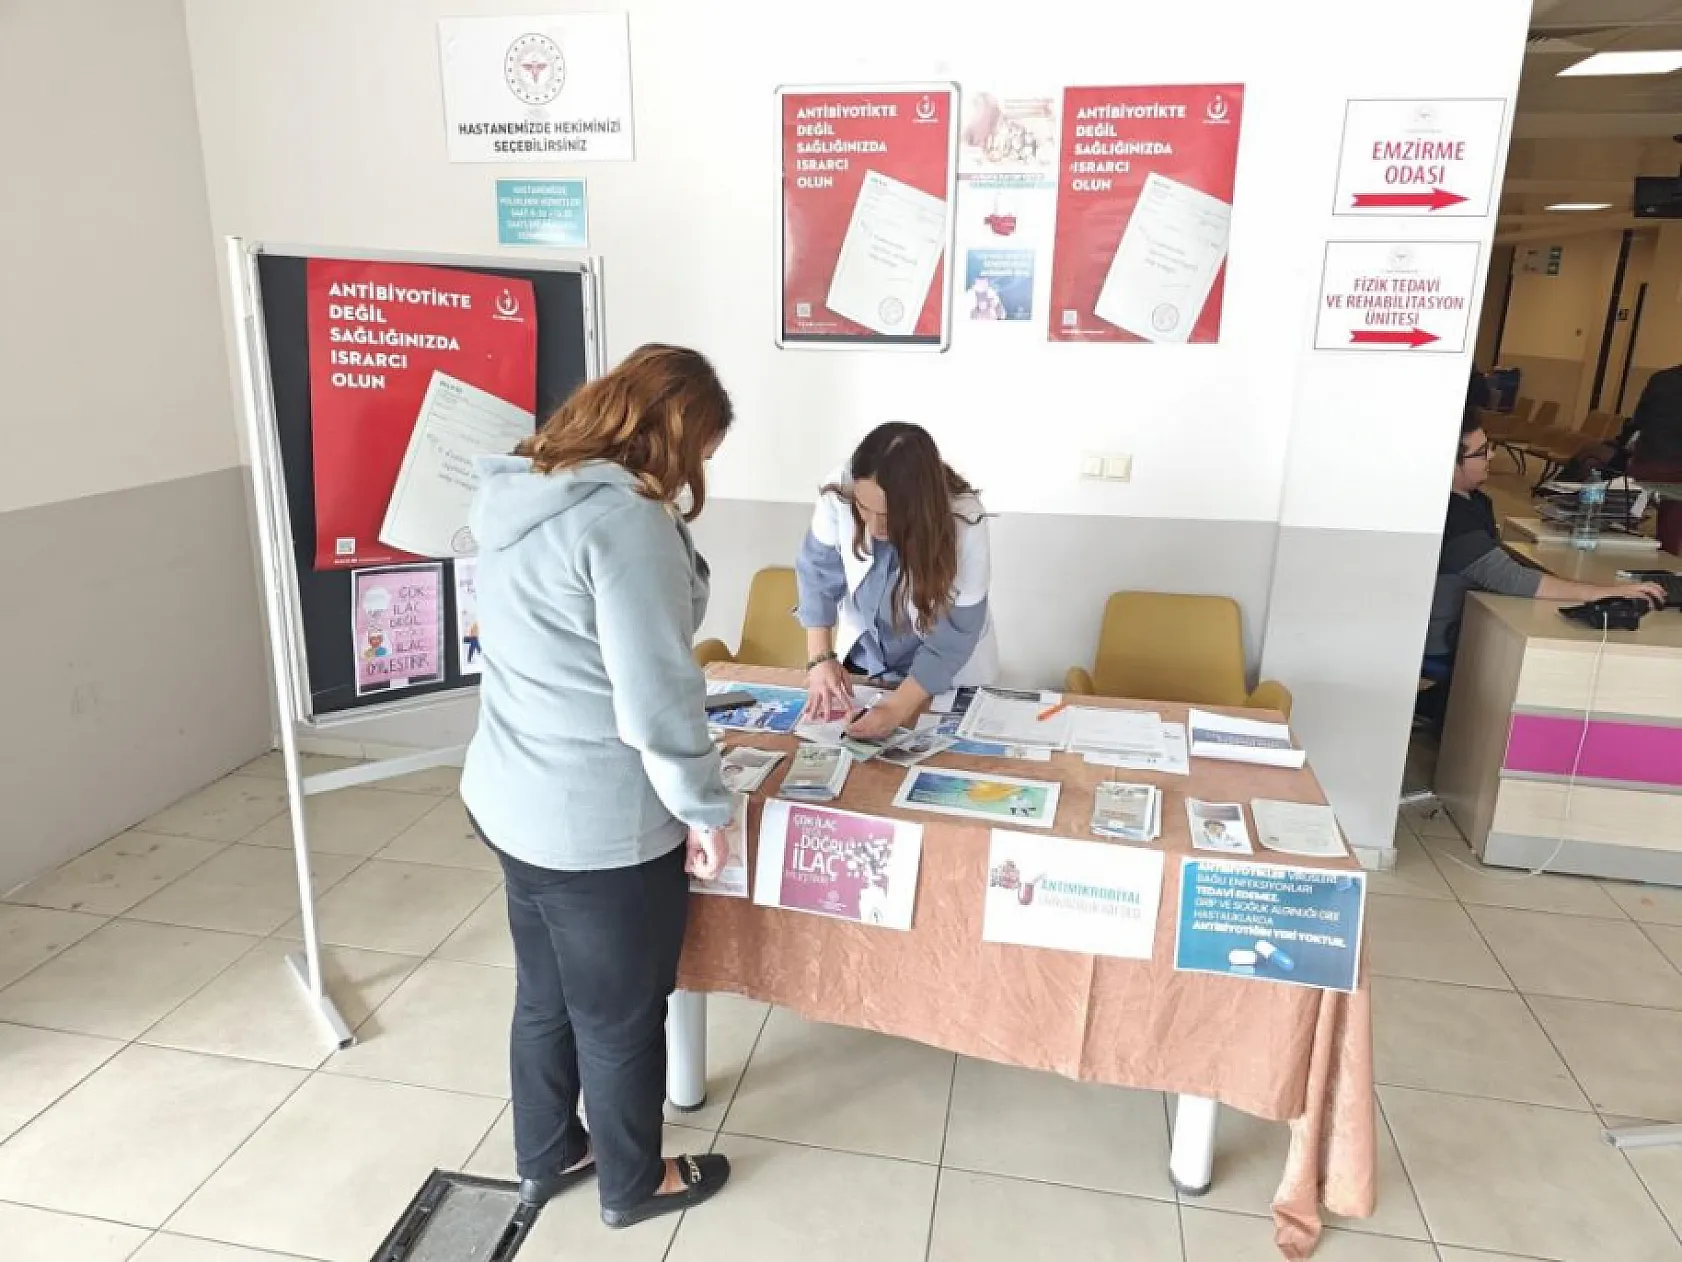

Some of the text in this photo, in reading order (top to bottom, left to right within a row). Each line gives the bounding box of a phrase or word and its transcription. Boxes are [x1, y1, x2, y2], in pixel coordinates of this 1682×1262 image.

[797, 103, 898, 118] ANTİBİYOTİKTE
[1076, 103, 1187, 118] ANTİBİYOTİKTE
[458, 117, 622, 135] HASTANEMİZDE HEKİMİNİZİ
[797, 122, 835, 136] DEĞİL
[1076, 123, 1117, 137] DEĞİL
[494, 137, 588, 153] SEÇEBİLİRSİNİZ
[797, 138, 887, 153] SAĞLIĞINIZDA
[1075, 140, 1172, 155] SAĞLIĞINIZDA
[1372, 138, 1466, 160] EMZİRME
[797, 158, 848, 171] ISRARCI
[1073, 161, 1130, 173] ISRARCI
[797, 176, 833, 188] OLUN
[1385, 164, 1446, 184] ODASI
[1072, 179, 1112, 191] OLUN
[1354, 276, 1441, 292] FİZİK TEDAVİ
[329, 281, 471, 309] ANTİBİYOTİKTE
[1326, 294, 1465, 310] VE REHABİLİTASYON
[329, 303, 387, 323] DEĞİL
[1364, 310, 1420, 326] ÜNİTESİ
[330, 326, 460, 351] SAĞLIĞINIZDA
[331, 350, 408, 369] ISRARCI
[331, 373, 385, 389] OLUN
[793, 842, 841, 876] İLAÇ
